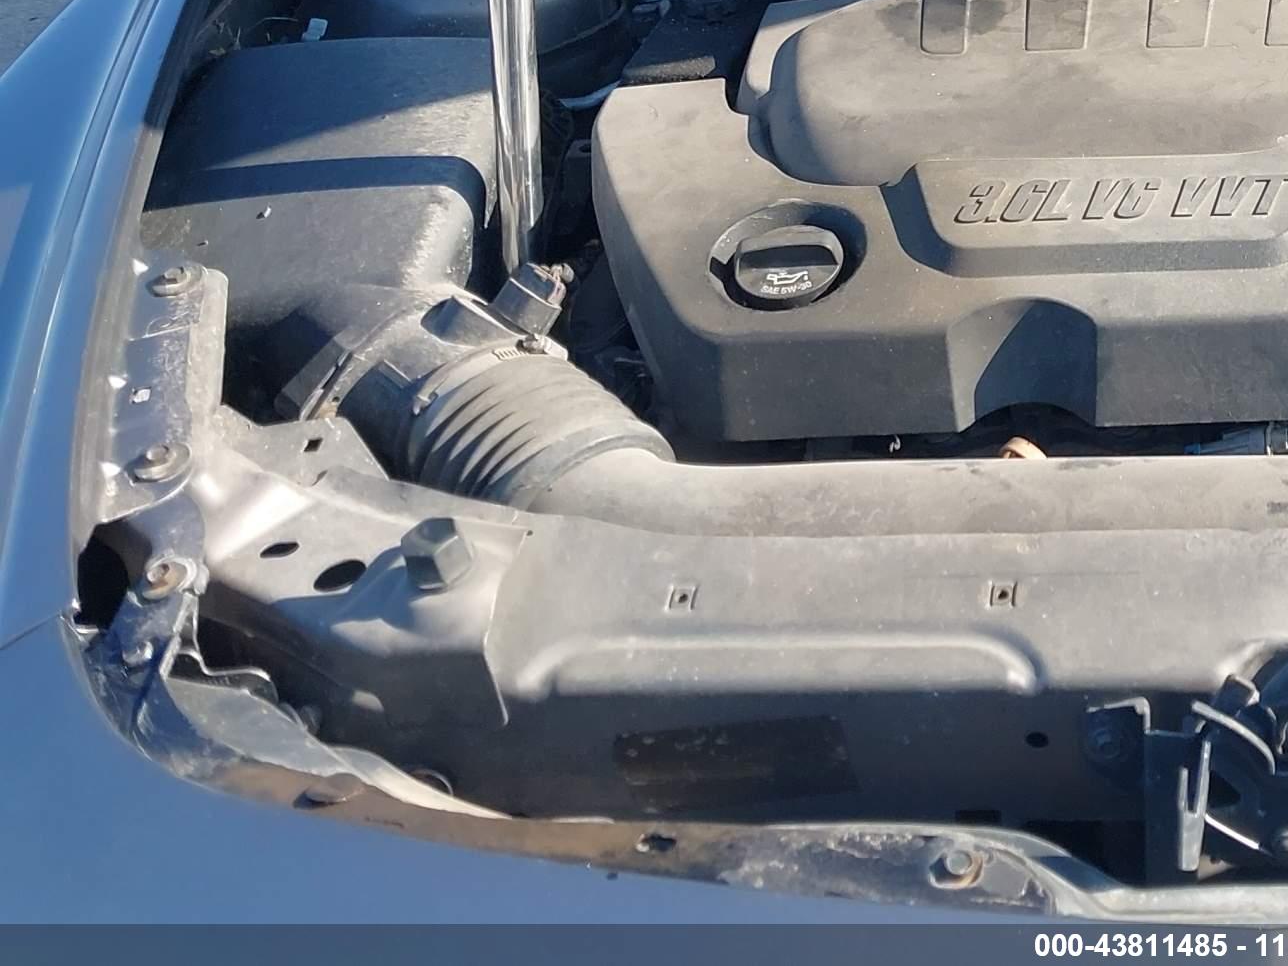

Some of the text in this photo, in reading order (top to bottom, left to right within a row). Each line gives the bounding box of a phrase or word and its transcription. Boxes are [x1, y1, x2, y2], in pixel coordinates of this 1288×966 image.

[952, 178, 1071, 224] 3.6L
[1081, 177, 1162, 221] V6
[761, 281, 813, 295] SAE 5W-30
